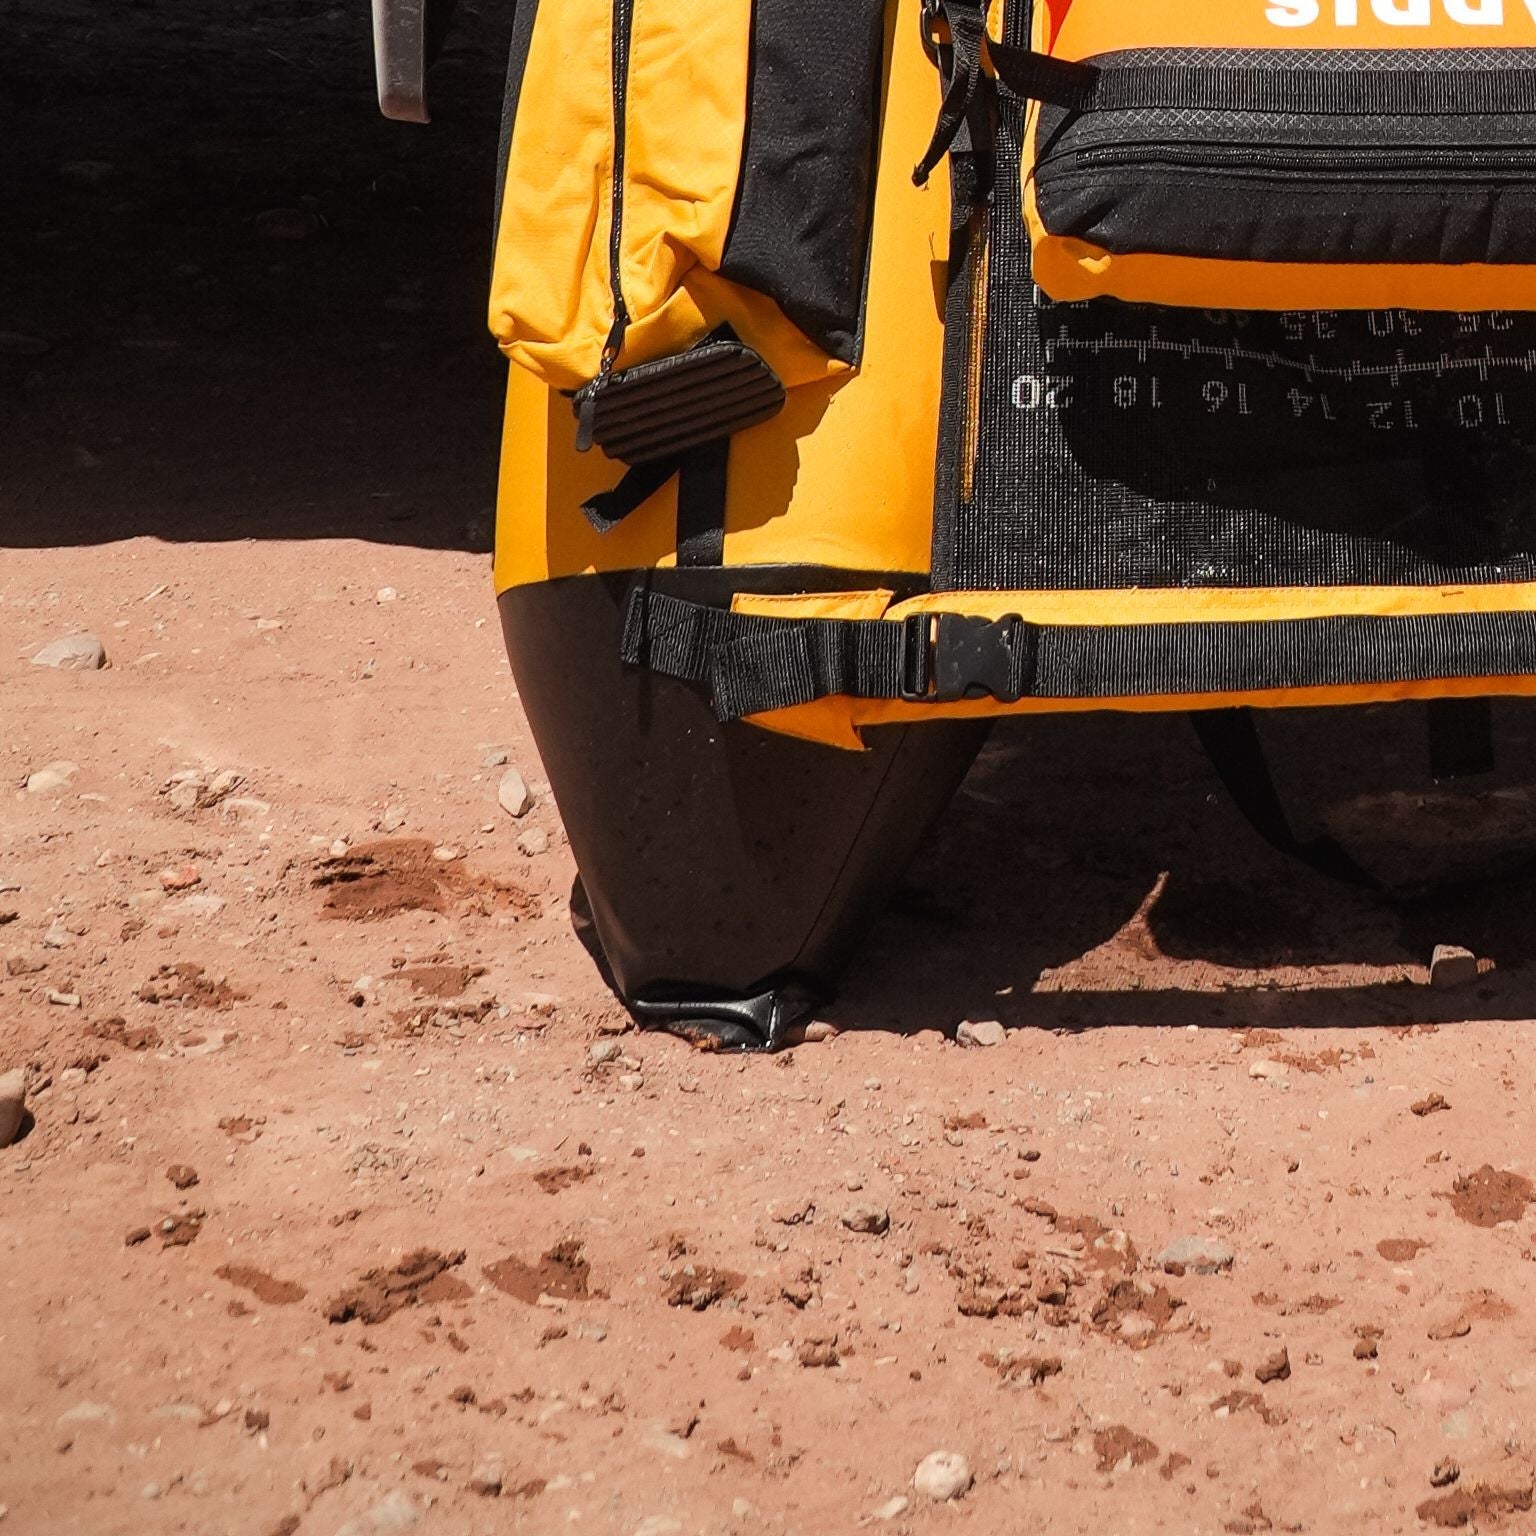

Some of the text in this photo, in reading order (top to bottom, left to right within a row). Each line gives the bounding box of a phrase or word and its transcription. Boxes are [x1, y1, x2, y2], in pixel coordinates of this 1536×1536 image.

[1011, 374, 1074, 409] 20
[1113, 375, 1163, 410] 18
[1202, 380, 1252, 414] 16
[1286, 388, 1337, 420] 14
[1366, 401, 1418, 430] 12
[1459, 393, 1511, 428] 10
